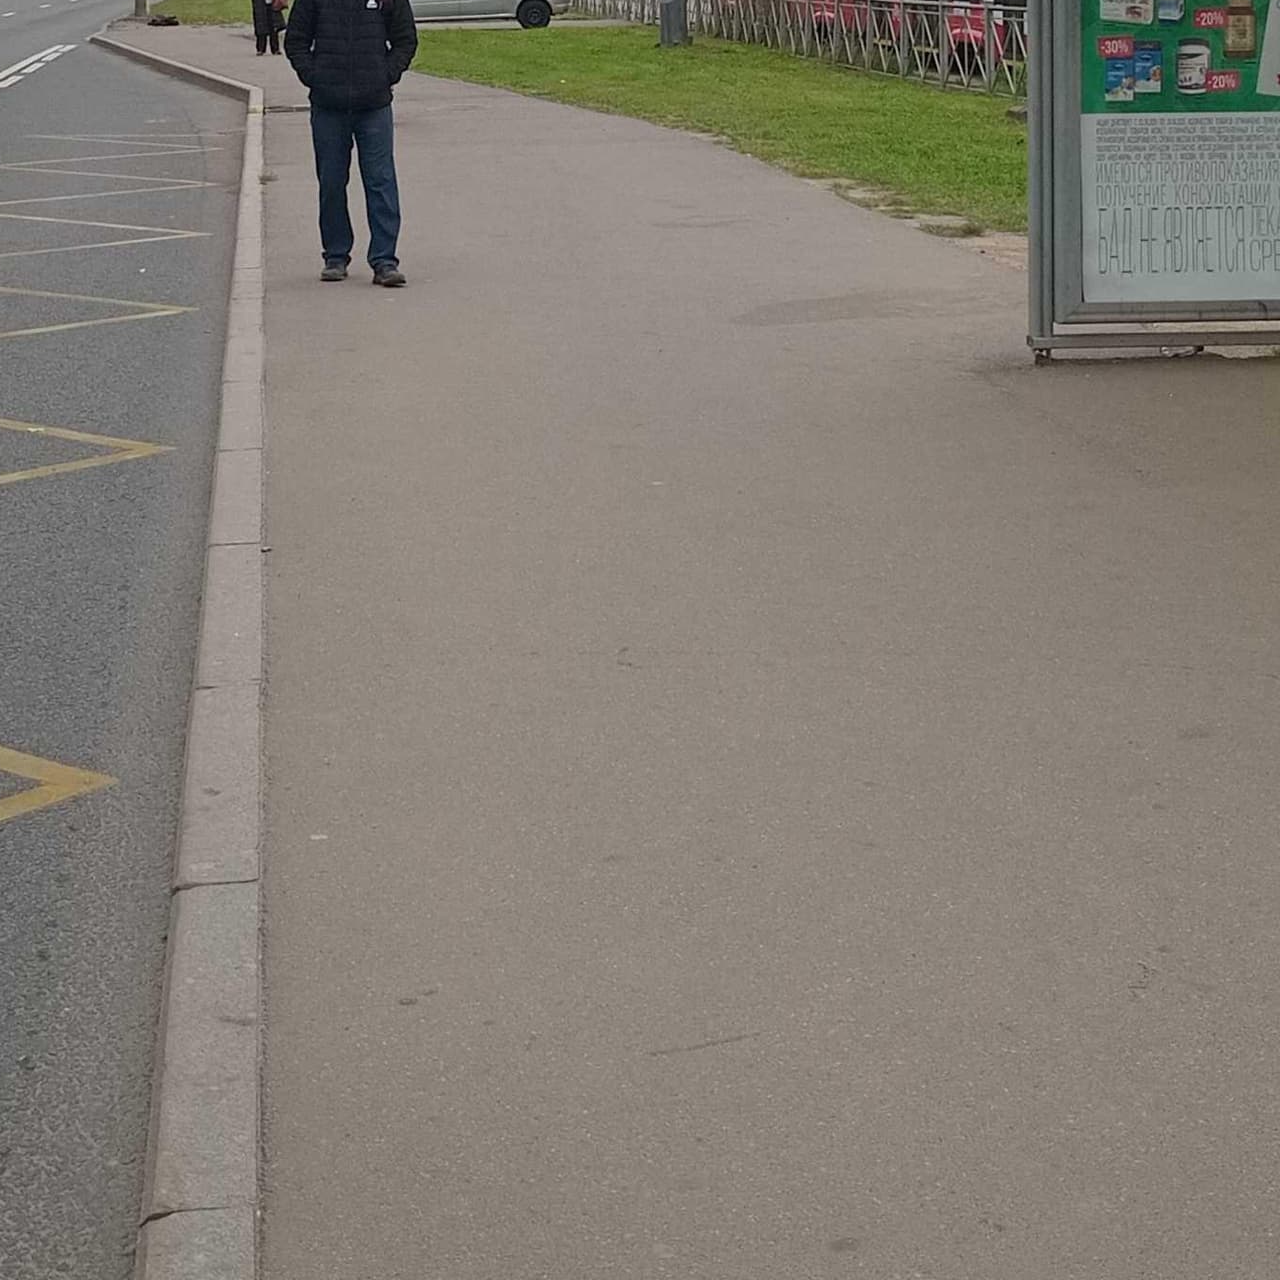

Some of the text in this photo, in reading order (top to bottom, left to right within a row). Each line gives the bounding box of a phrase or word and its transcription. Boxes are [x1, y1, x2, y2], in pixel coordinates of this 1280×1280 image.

[1195, 12, 1224, 26] -20%
[1100, 39, 1129, 54] -30%
[1208, 75, 1236, 89] -20%
[1096, 161, 1152, 184] ИМЕЮТСЯ
[1096, 184, 1167, 206] ПОЛУЧЕНИЕ
[1174, 182, 1270, 205] КОНСУЛЬТАЦИИ
[1098, 205, 1245, 274] БАД НЕ ЯВЛЯЕТСЯ
